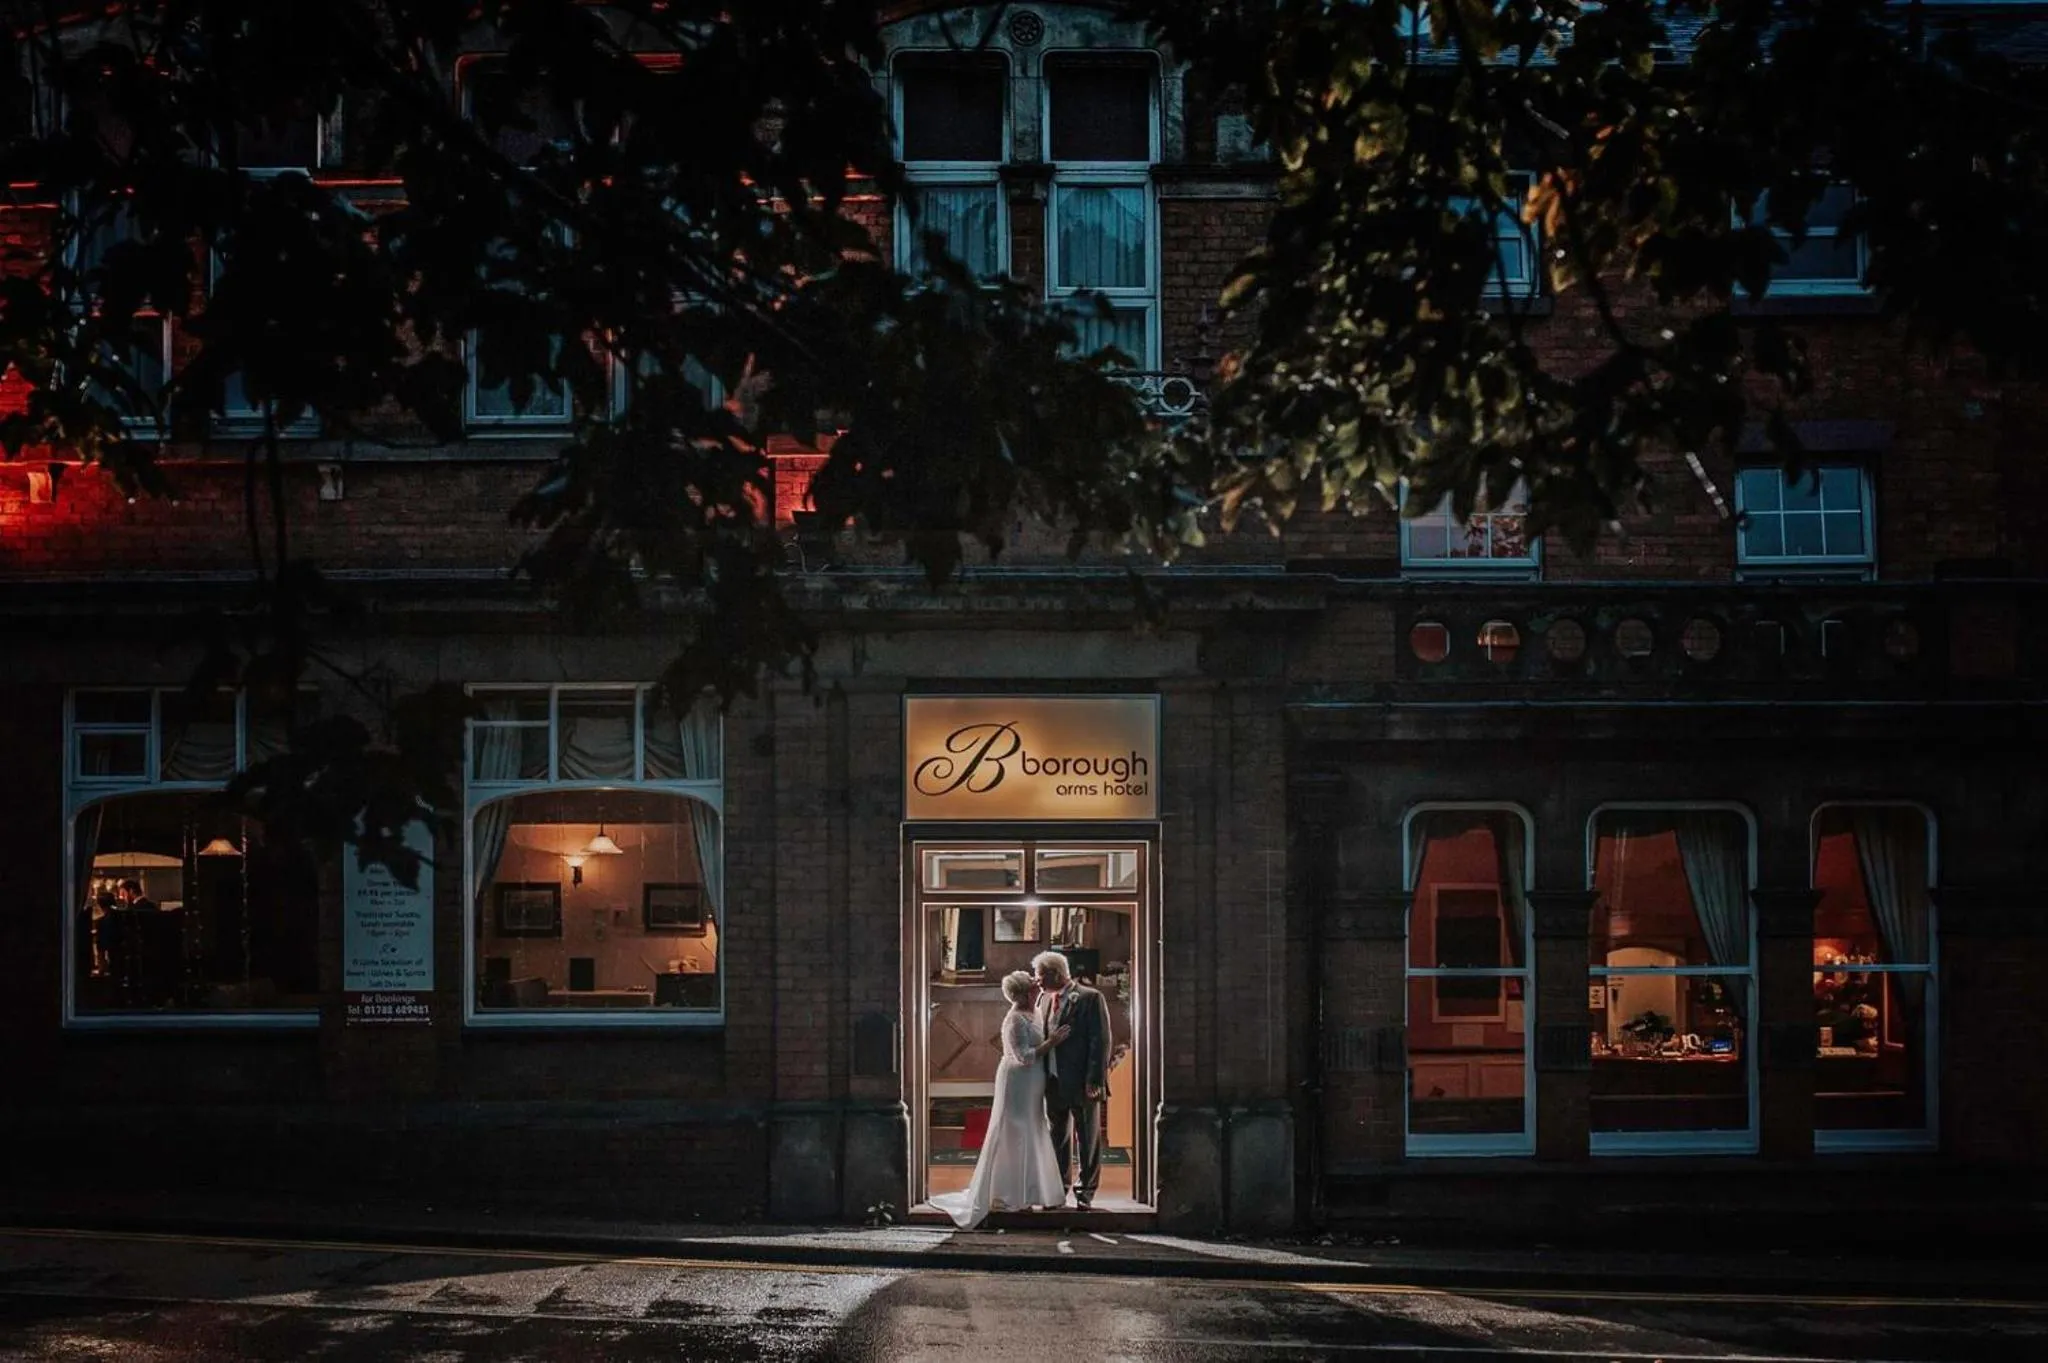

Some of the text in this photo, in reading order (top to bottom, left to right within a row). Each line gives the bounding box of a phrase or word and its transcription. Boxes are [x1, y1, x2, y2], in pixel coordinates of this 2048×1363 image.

[914, 721, 1148, 796] B borough
[1056, 781, 1148, 796] arms hotel
